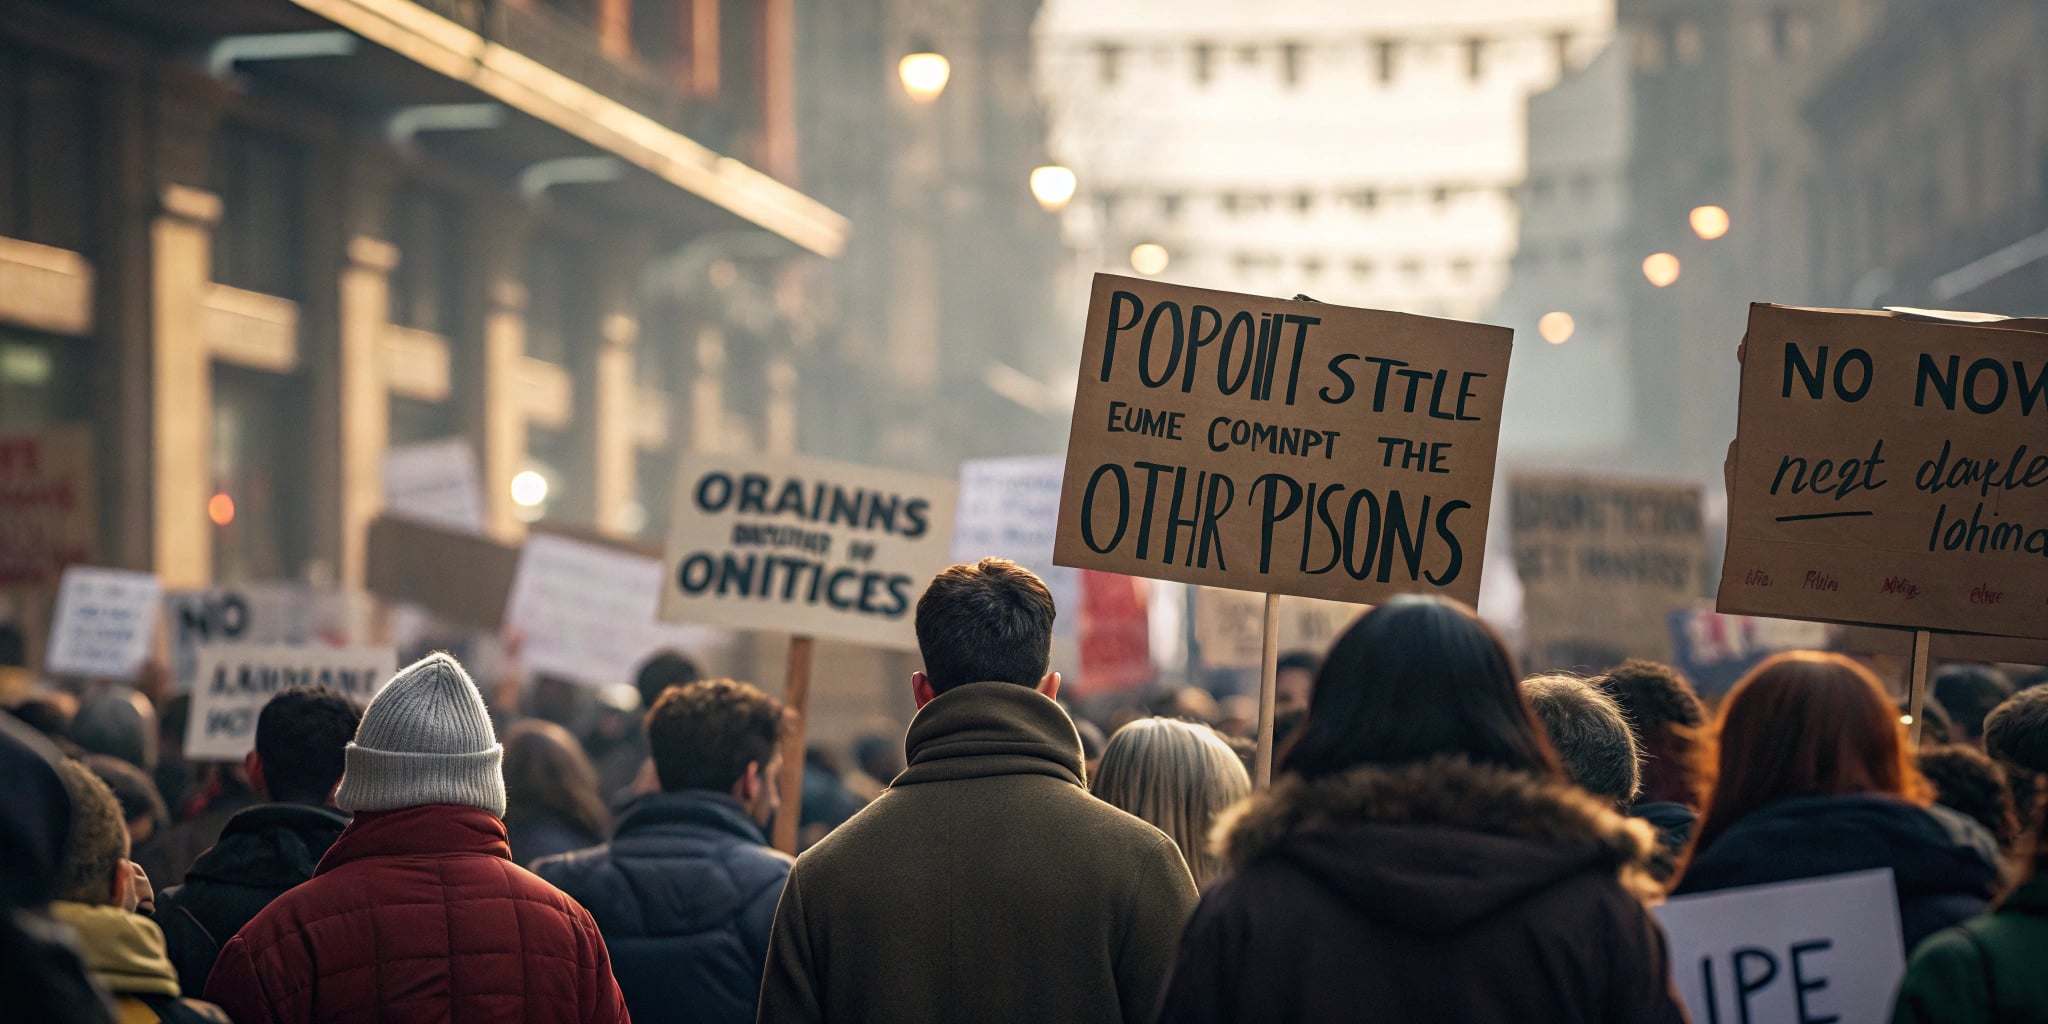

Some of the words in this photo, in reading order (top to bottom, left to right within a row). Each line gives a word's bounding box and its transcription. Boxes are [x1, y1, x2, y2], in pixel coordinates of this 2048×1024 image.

[1318, 353, 1488, 421] STTLE
[1782, 342, 1873, 403] NO
[1107, 401, 1186, 441] EUME
[1377, 436, 1453, 474] THE
[695, 472, 929, 538] ORAINNS
[1081, 462, 1235, 571] OTHR
[679, 552, 912, 619] ONITICES
[1703, 938, 1841, 1024] IPE
